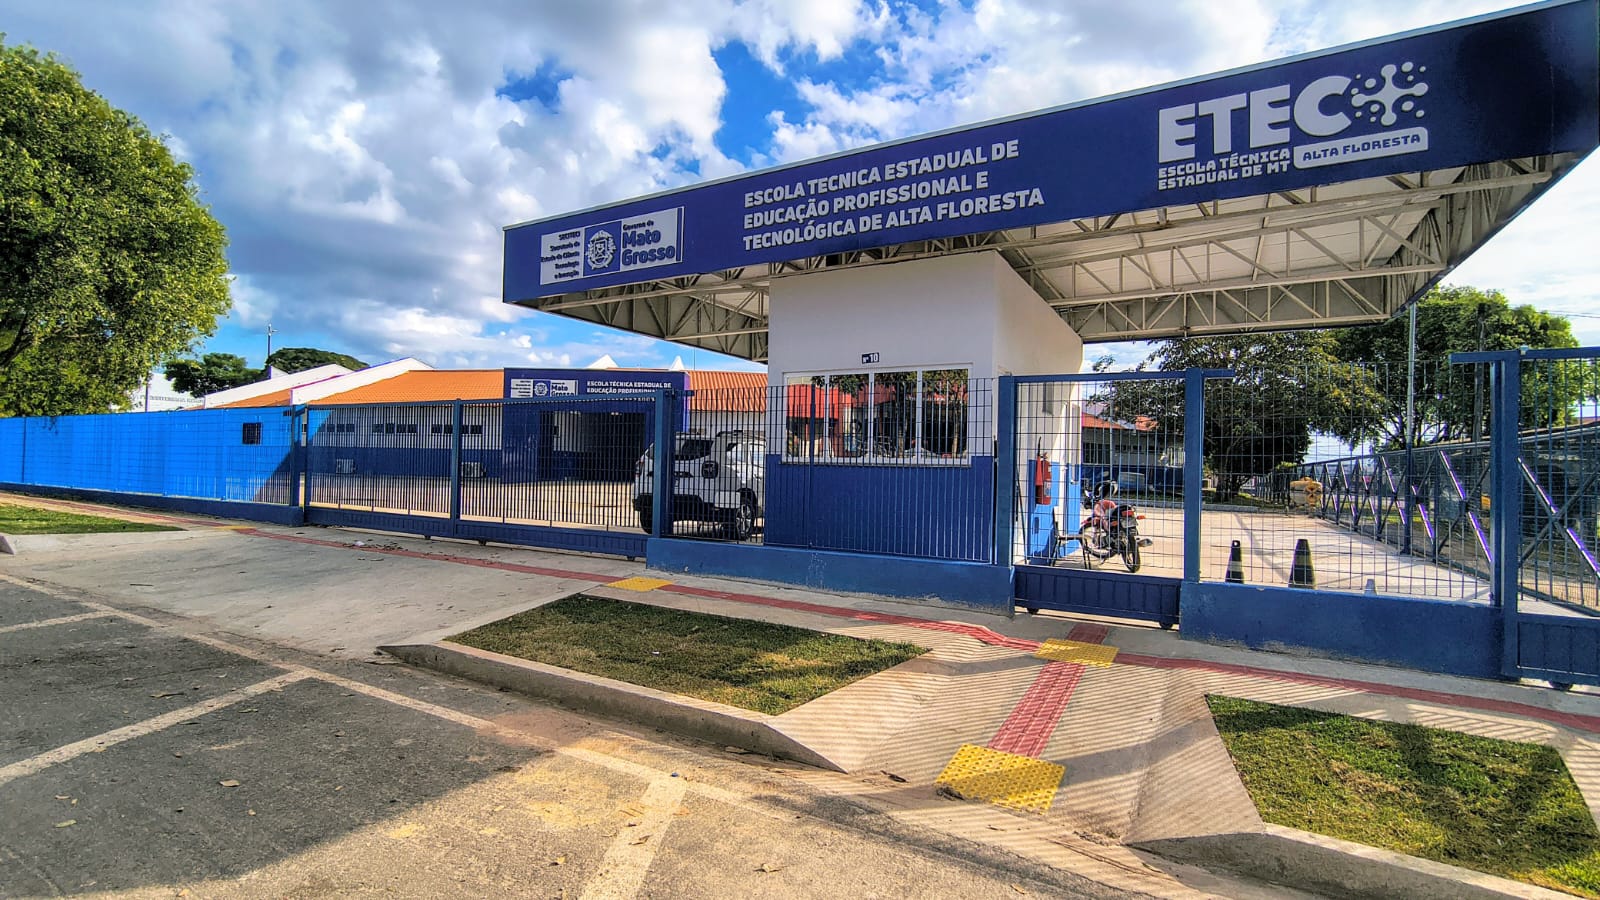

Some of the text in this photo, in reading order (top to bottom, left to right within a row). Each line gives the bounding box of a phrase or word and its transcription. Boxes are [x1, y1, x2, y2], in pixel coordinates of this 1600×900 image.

[1158, 75, 1353, 164] ETEC
[1158, 147, 1291, 179] ESCOLA TÉCNICA
[1302, 133, 1421, 162] ALTA FLORESTA
[744, 182, 806, 208] ESCOLA
[884, 146, 987, 181] ESTADUAL
[991, 139, 1019, 162] DE
[1158, 160, 1291, 191] ESTADUAL DE MT
[743, 171, 989, 230] EDUCAÇÃO PROFISSIONAL E
[743, 187, 1045, 251] TECNOLÓGICA DE ALTA FLORESTA
[622, 229, 661, 248] Mato
[622, 245, 675, 266] Grosso
[551, 384, 569, 392] Mato
[586, 386, 617, 395] EDUCAÇÃO
